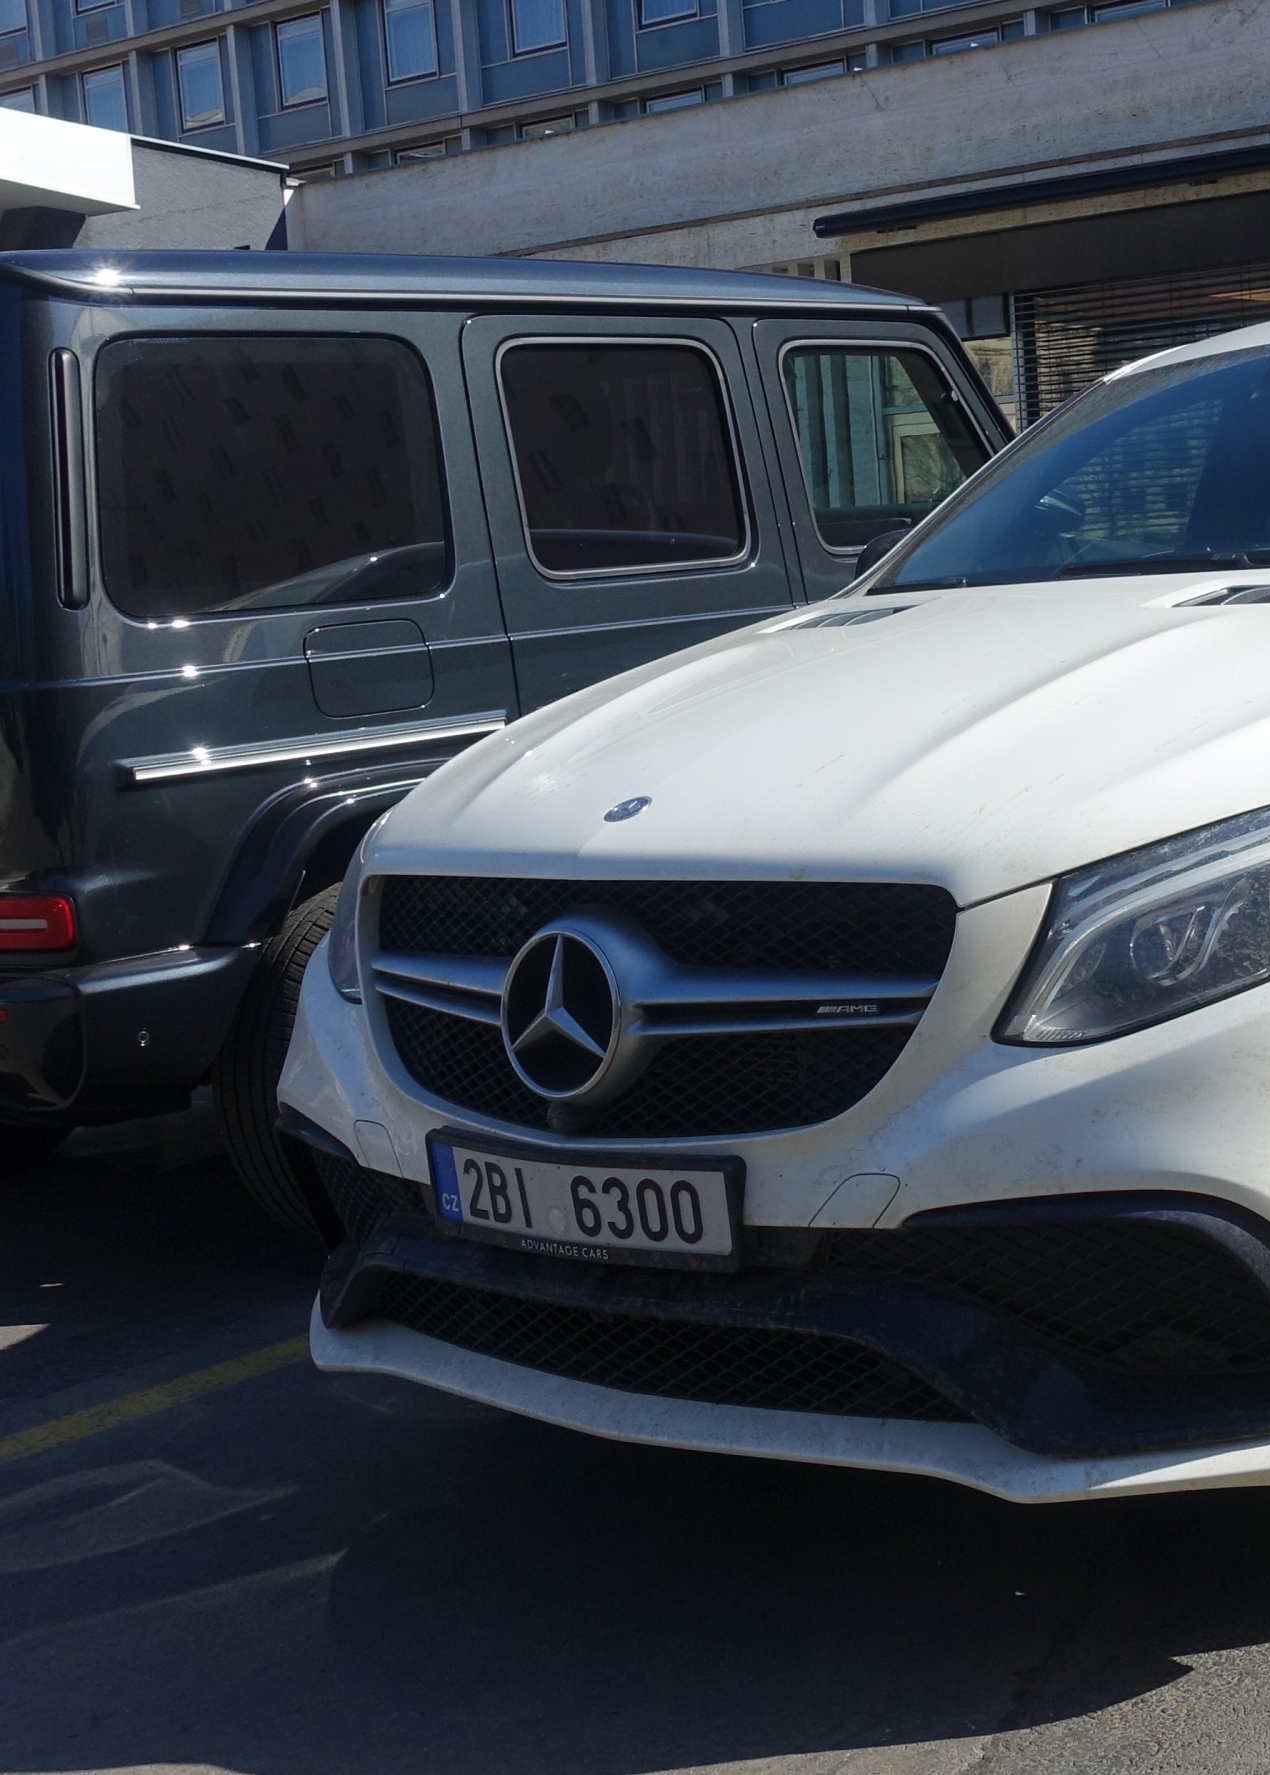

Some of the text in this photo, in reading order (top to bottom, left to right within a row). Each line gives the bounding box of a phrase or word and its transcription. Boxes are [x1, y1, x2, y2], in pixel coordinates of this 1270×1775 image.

[836, 1004, 877, 1013] AMG
[443, 1193, 460, 1213] CZ
[463, 1158, 704, 1244] 2BI 6300
[521, 1239, 609, 1260] ADVANTAGE CARS
